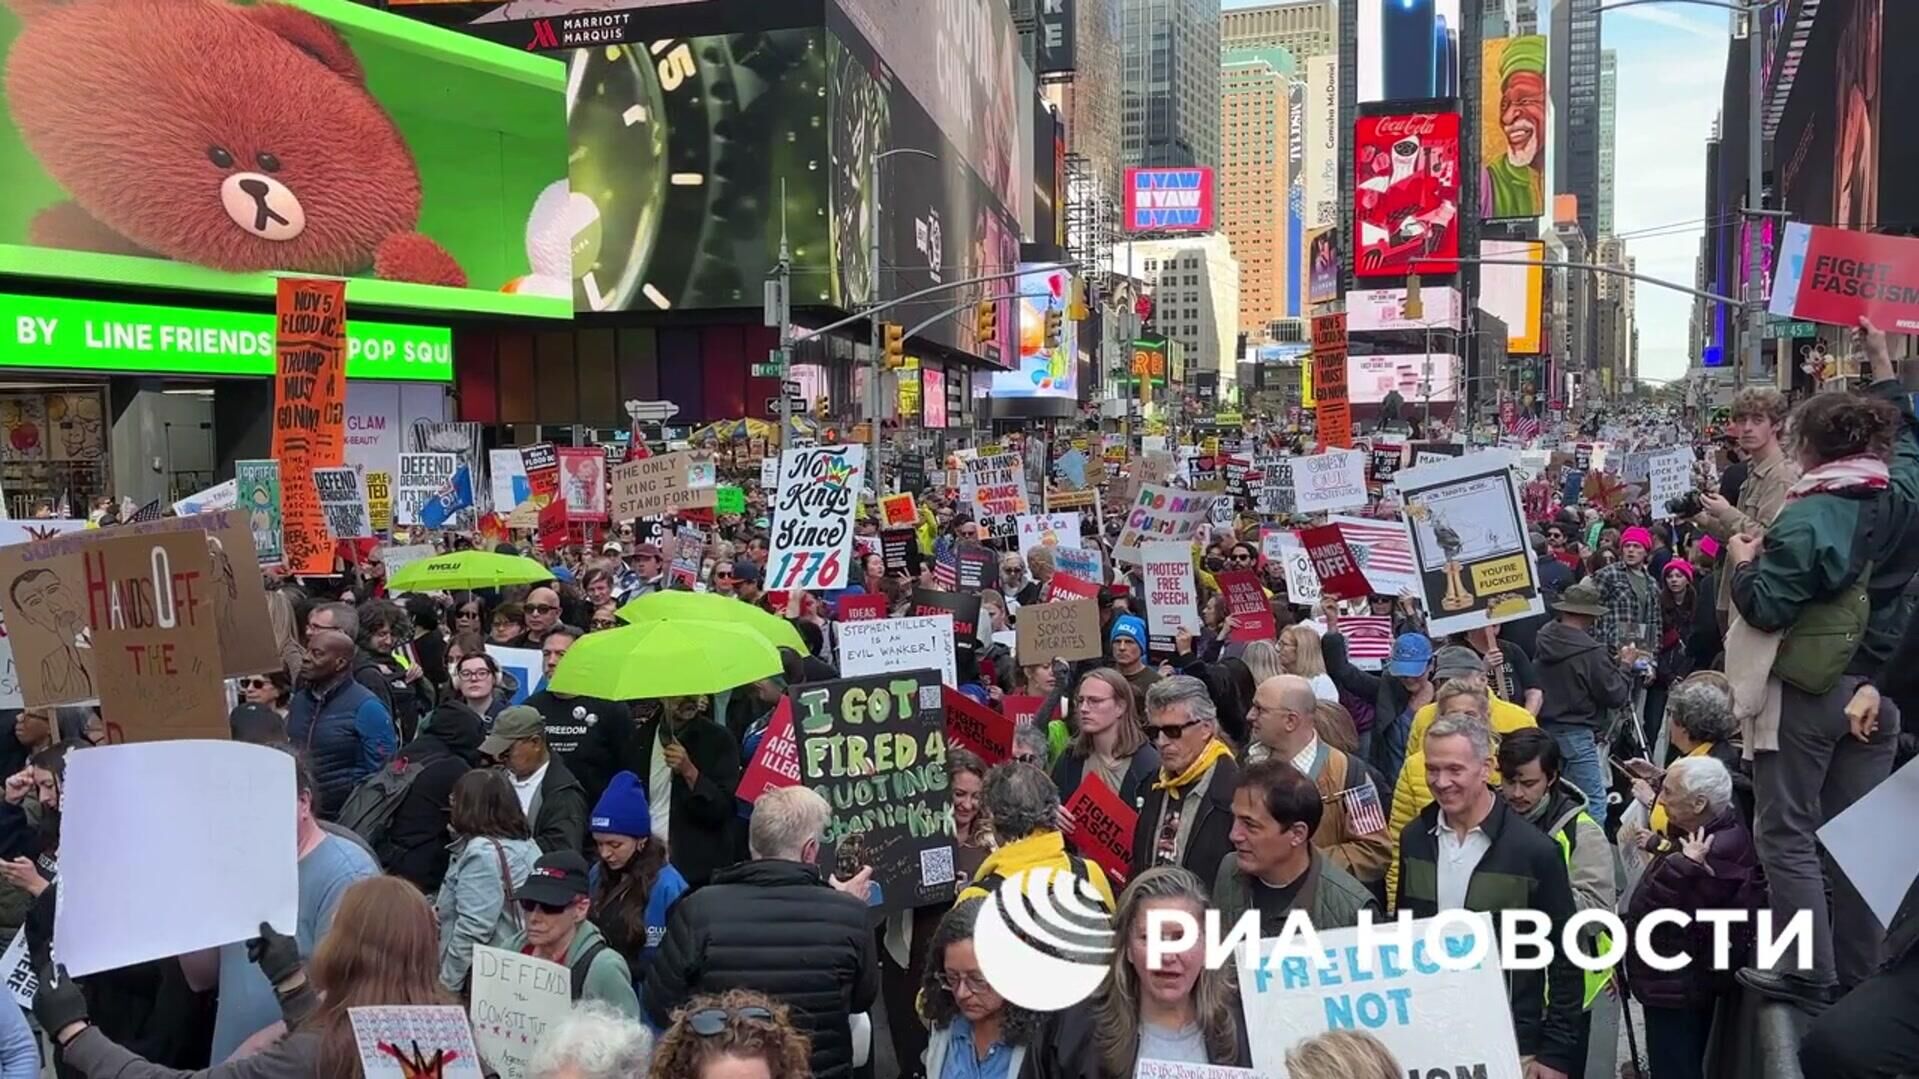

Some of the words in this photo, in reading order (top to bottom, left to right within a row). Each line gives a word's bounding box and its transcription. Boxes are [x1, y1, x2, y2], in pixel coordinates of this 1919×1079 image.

[563, 13, 630, 29] MARRIOTT
[563, 28, 624, 44] MARQUIS
[1326, 62, 1335, 104] McDaniel
[1135, 171, 1202, 191] NYAW
[1135, 189, 1201, 208] NYAW
[1135, 207, 1202, 228] NYAW
[1815, 255, 1892, 281] FIGHT
[1811, 273, 1919, 305] FASCISM
[323, 295, 334, 314] 5
[16, 316, 58, 345] BY
[85, 320, 153, 350] LINE
[159, 325, 273, 357] FRIENDS
[1776, 325, 1787, 335] W
[1791, 323, 1803, 334] 45
[348, 337, 396, 361] POP
[281, 351, 326, 376] TRUMP
[1317, 354, 1344, 369] TRUMP
[1320, 369, 1343, 383] MUST
[347, 416, 385, 430] GLAM
[401, 455, 453, 475] DEFEND
[615, 467, 640, 481] THE
[642, 457, 677, 476] ONLY
[788, 446, 848, 480] No
[315, 470, 356, 490] DEFEND
[626, 480, 657, 496] KING
[664, 476, 676, 488] I
[619, 496, 661, 514] STAND
[779, 482, 851, 518] Kings
[776, 517, 848, 550] Since
[1310, 543, 1345, 560] HANDS
[427, 563, 461, 571] NYCLU
[771, 549, 841, 589] 1776
[1147, 562, 1190, 577] PROTECT
[1316, 555, 1354, 578] OFF!
[1480, 563, 1517, 577] YOU'RE
[1157, 576, 1182, 591] FREE
[1151, 591, 1189, 606] SPEECH
[848, 607, 877, 618] IDEAS
[1034, 604, 1078, 621] TODOS
[843, 623, 891, 637] STEPHEN
[894, 618, 937, 631] MILLER
[1037, 621, 1076, 638] SOMOS
[847, 649, 873, 660] EVIL
[880, 635, 937, 656] WANKER!
[126, 645, 176, 676] THE
[799, 688, 834, 733] I
[841, 679, 919, 724] GOT
[544, 725, 588, 735] FREEDOM
[766, 735, 792, 760] ARE
[804, 732, 918, 779] FIRED
[1077, 793, 1124, 835] FIGHT
[647, 926, 667, 935] CLU
[479, 950, 568, 995] DEFEND
[478, 1000, 548, 1033] CONSTITUT
[1324, 987, 1413, 1031] NOT
